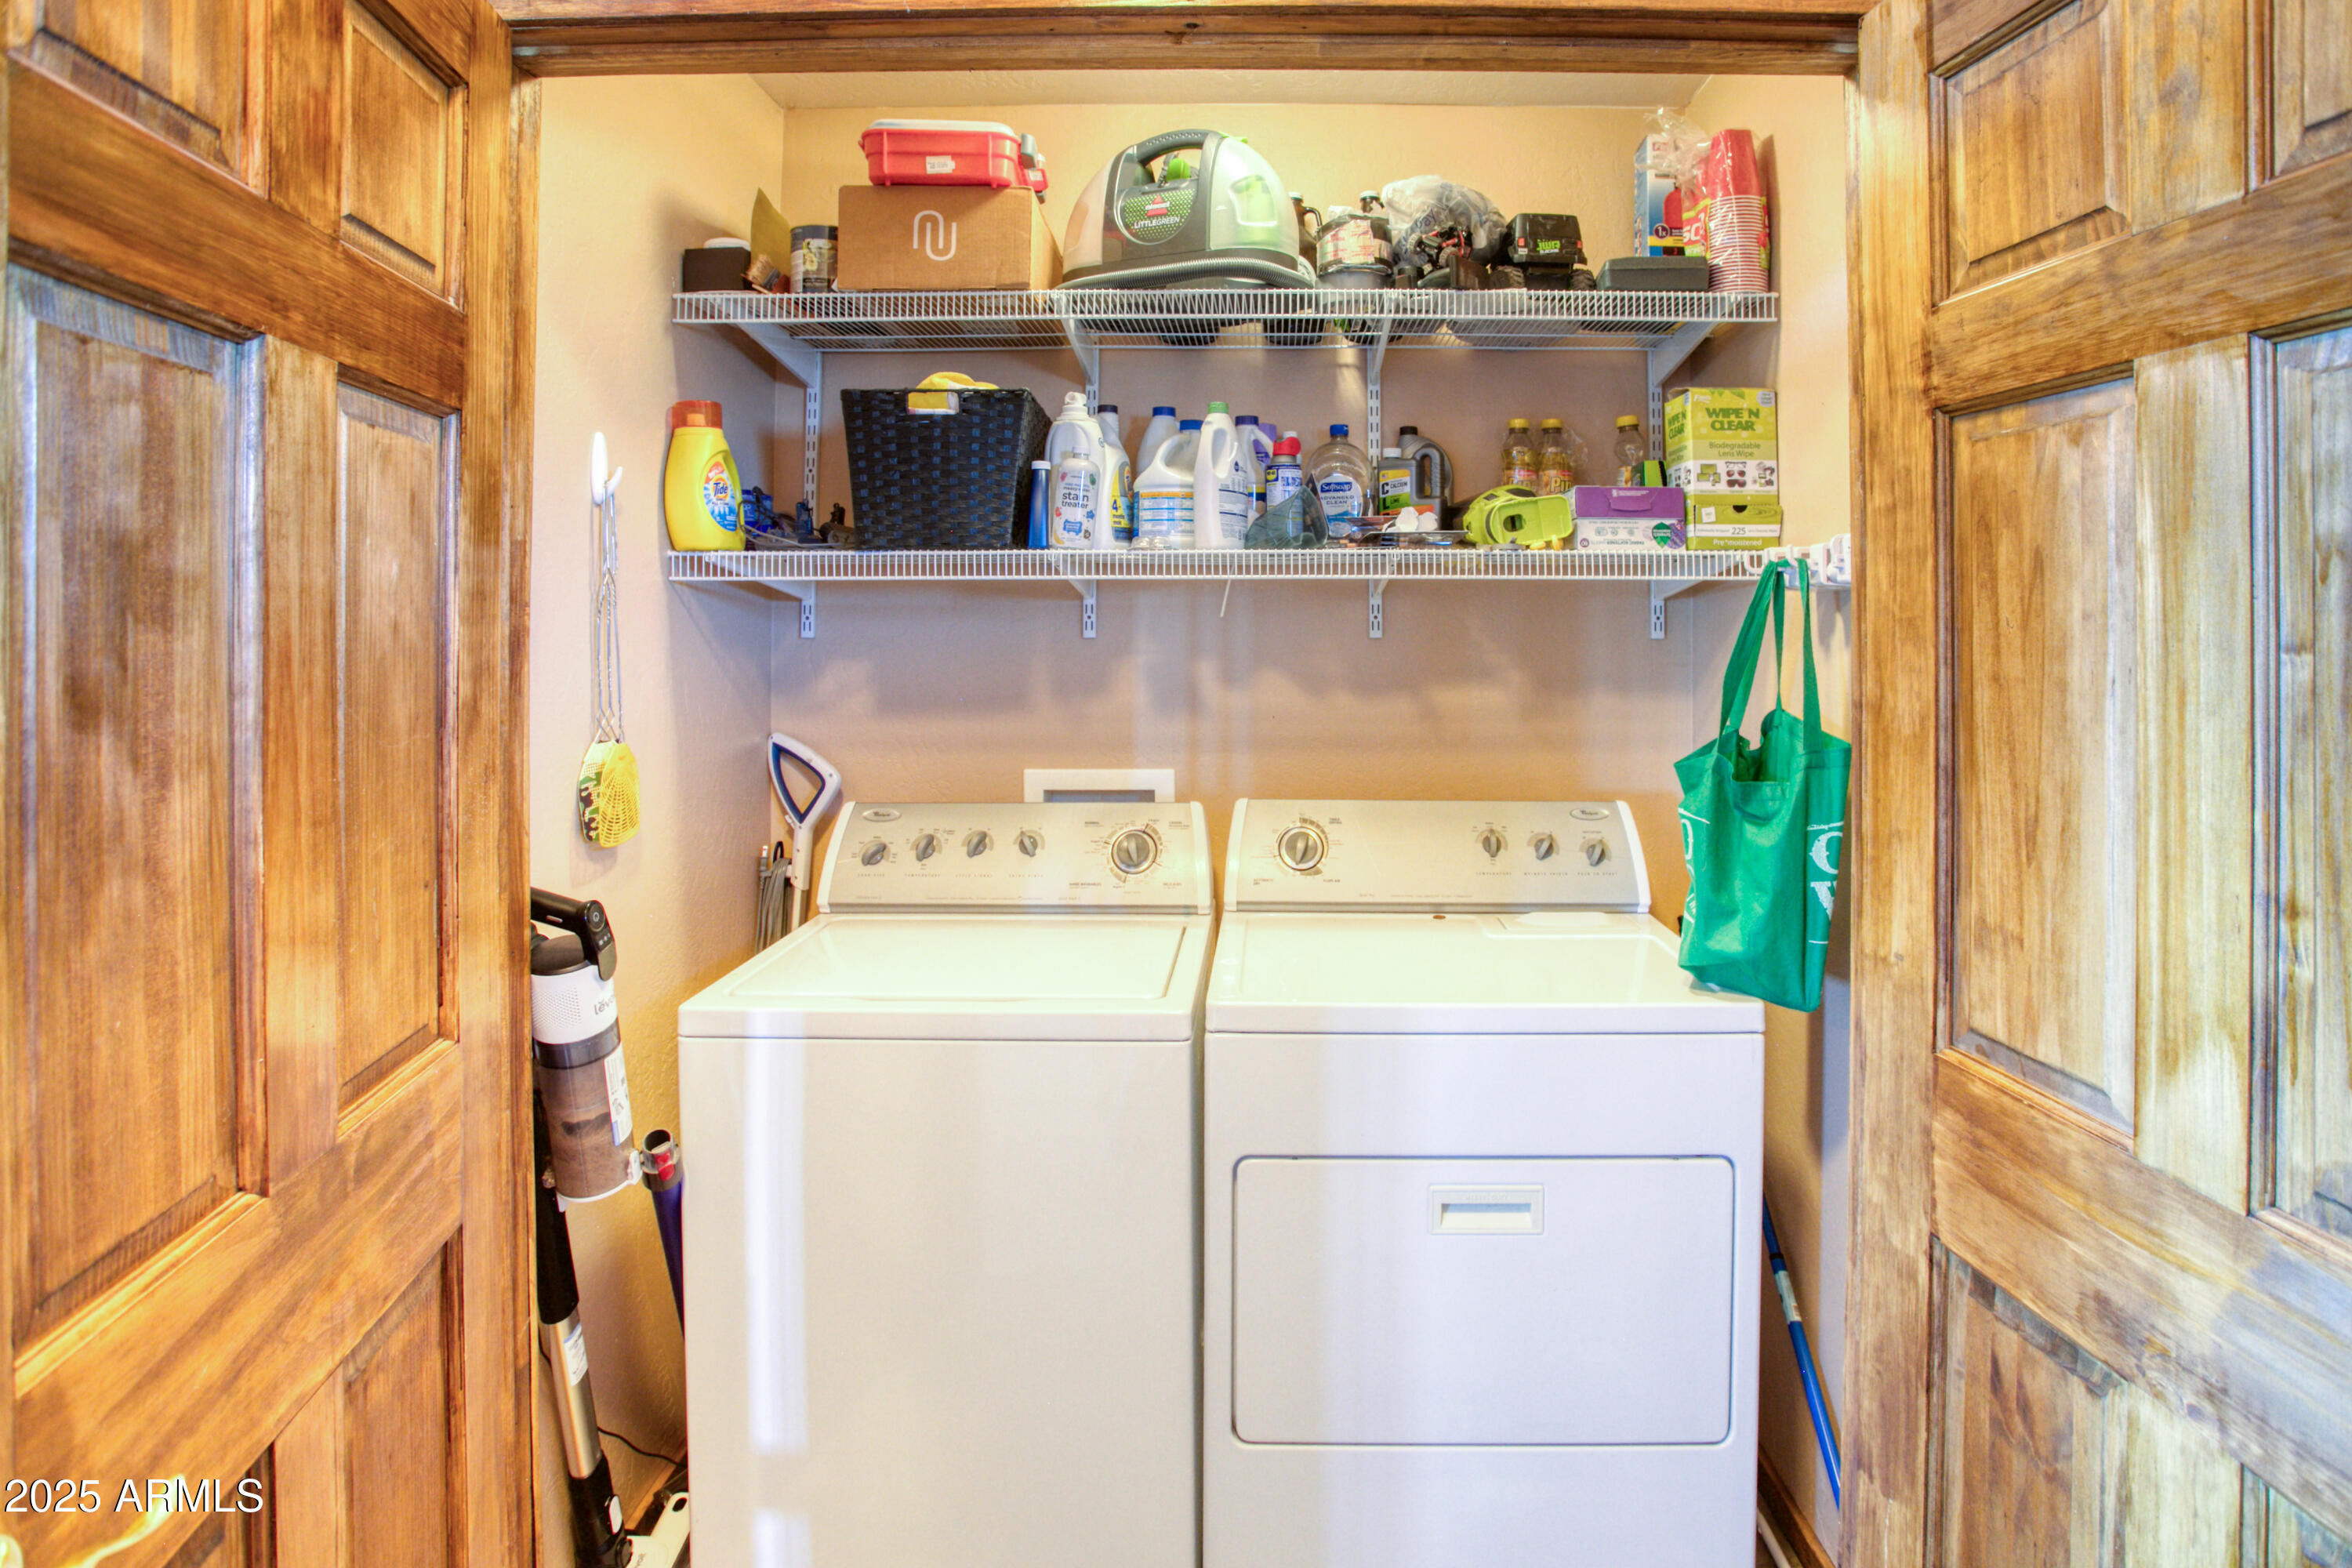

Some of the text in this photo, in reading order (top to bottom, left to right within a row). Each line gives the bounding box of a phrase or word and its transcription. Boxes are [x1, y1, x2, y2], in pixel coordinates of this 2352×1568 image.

[1134, 216, 1181, 229] LITTLEGREEN
[1705, 407, 1742, 419] WIPE
[1711, 419, 1756, 432] CLEAR
[1708, 441, 1761, 450] Biodegradable
[713, 481, 728, 498] Tide
[1322, 482, 1352, 492] Softsoap
[1062, 491, 1090, 503] stan
[1731, 526, 1747, 535] 225
